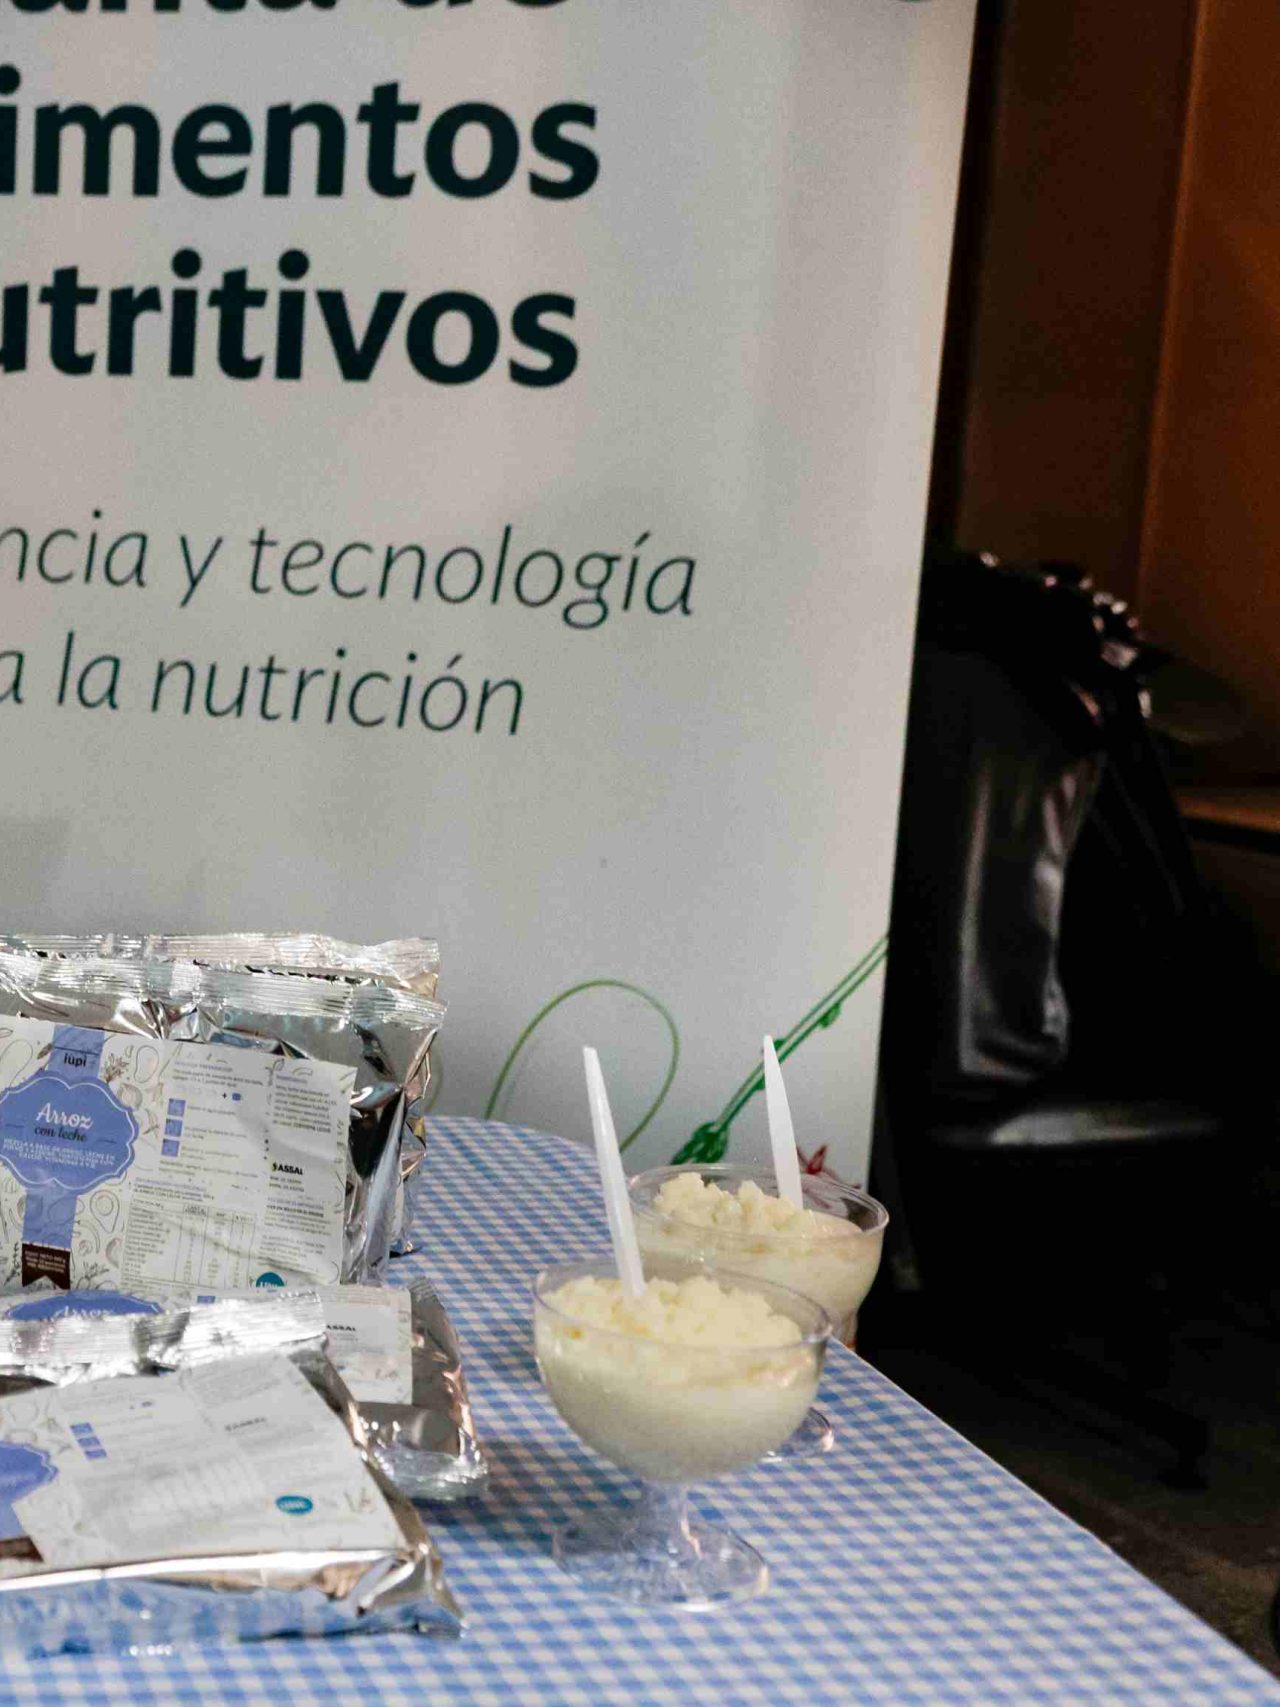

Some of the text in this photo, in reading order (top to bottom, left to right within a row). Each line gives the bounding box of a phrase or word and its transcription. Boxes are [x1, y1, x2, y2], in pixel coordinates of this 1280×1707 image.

[180, 535, 223, 608] y
[250, 524, 698, 630] tecnología
[57, 630, 121, 711] la
[151, 647, 524, 736] nutrición
[34, 1125, 87, 1142] con leche
[35, 1102, 95, 1130] Arroz
